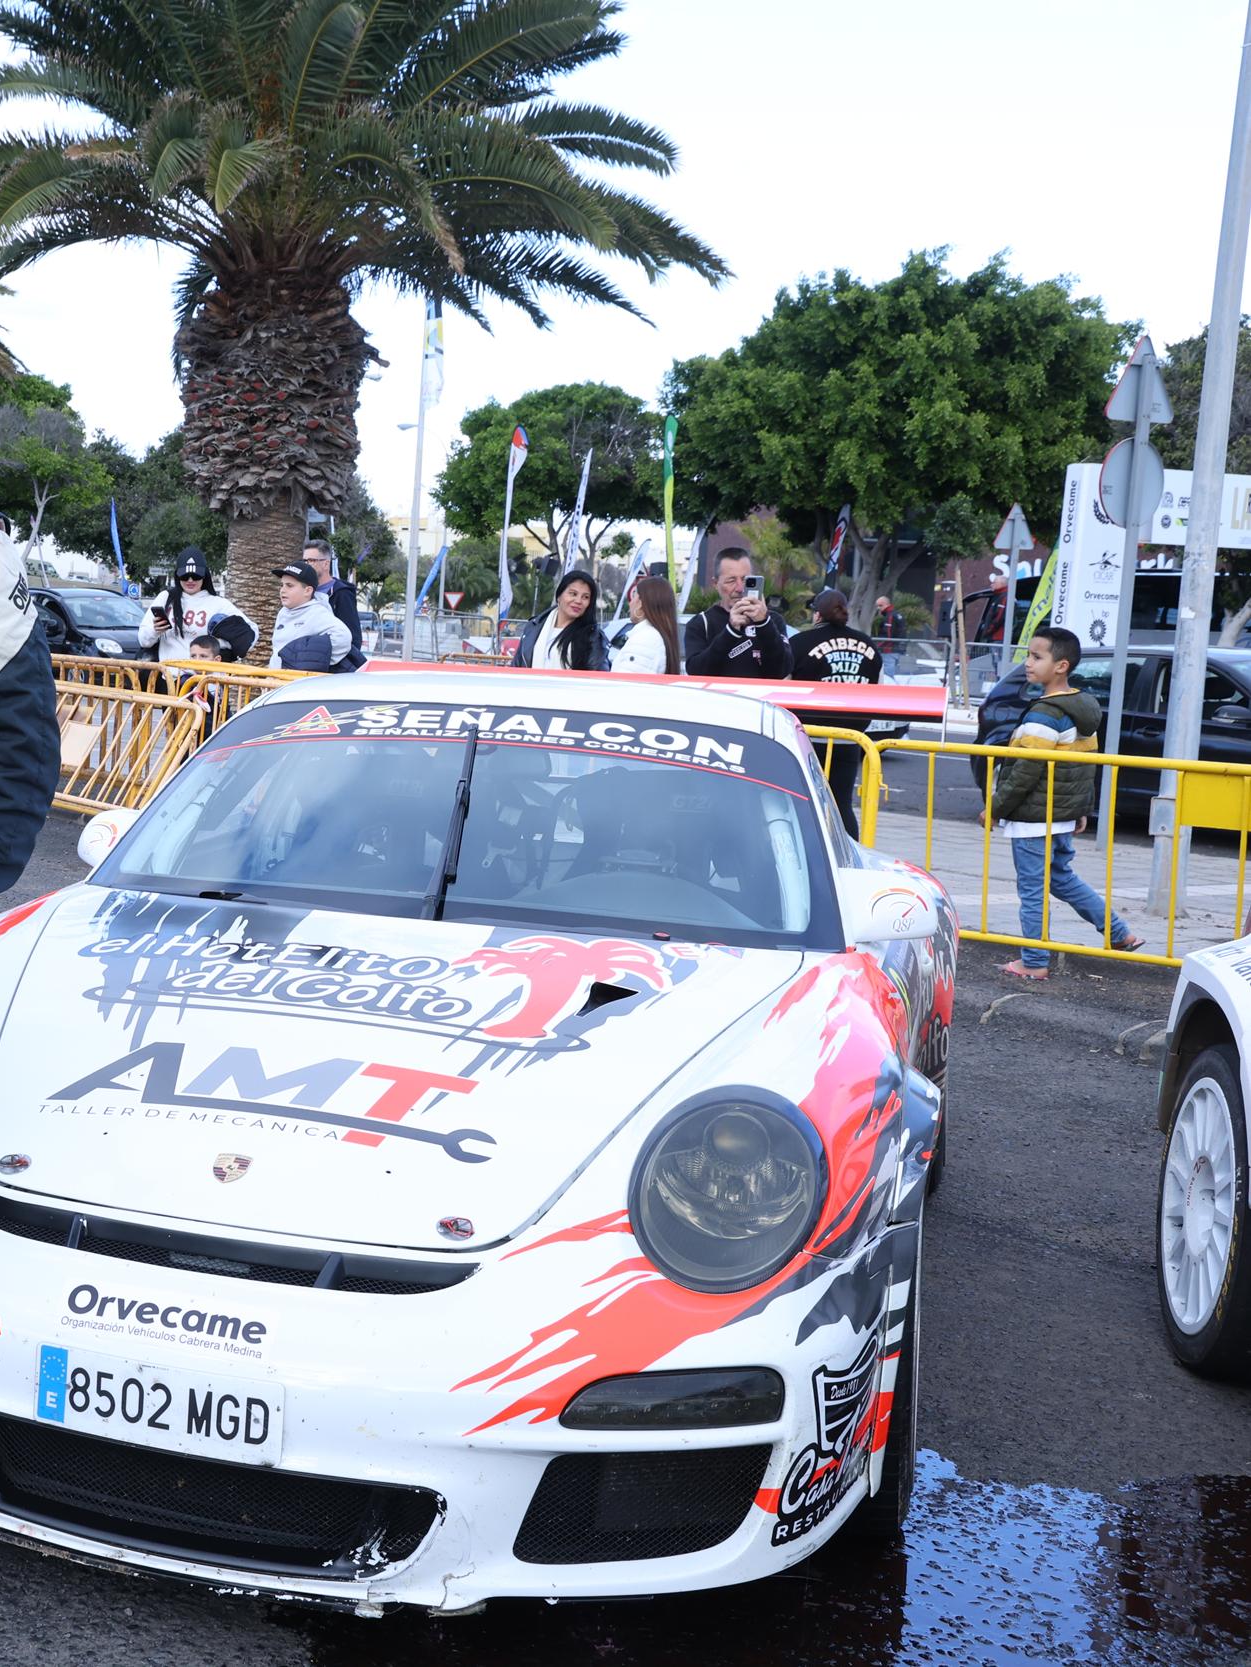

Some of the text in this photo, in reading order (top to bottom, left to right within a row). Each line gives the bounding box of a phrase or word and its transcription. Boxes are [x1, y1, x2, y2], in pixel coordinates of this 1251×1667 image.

[1063, 480, 1078, 544] Orvecame
[1054, 561, 1069, 625] Orvecame
[1084, 590, 1120, 601] Orvecame
[825, 651, 865, 664] PHILLY
[830, 661, 860, 674] MID
[357, 707, 747, 764] SEÑALCON
[584, 739, 747, 774] CONEJERAS
[90, 933, 150, 955] el
[893, 918, 915, 932] QSP
[171, 969, 474, 1018] del Golfo
[45, 1041, 479, 1147] AMT
[39, 1103, 340, 1142] TALLER DE MECÁNICA
[67, 1283, 268, 1345] Orvecame
[60, 1315, 263, 1360] Organización Vehículos Cabrera Medina
[45, 1367, 270, 1446] E 8502 MGD
